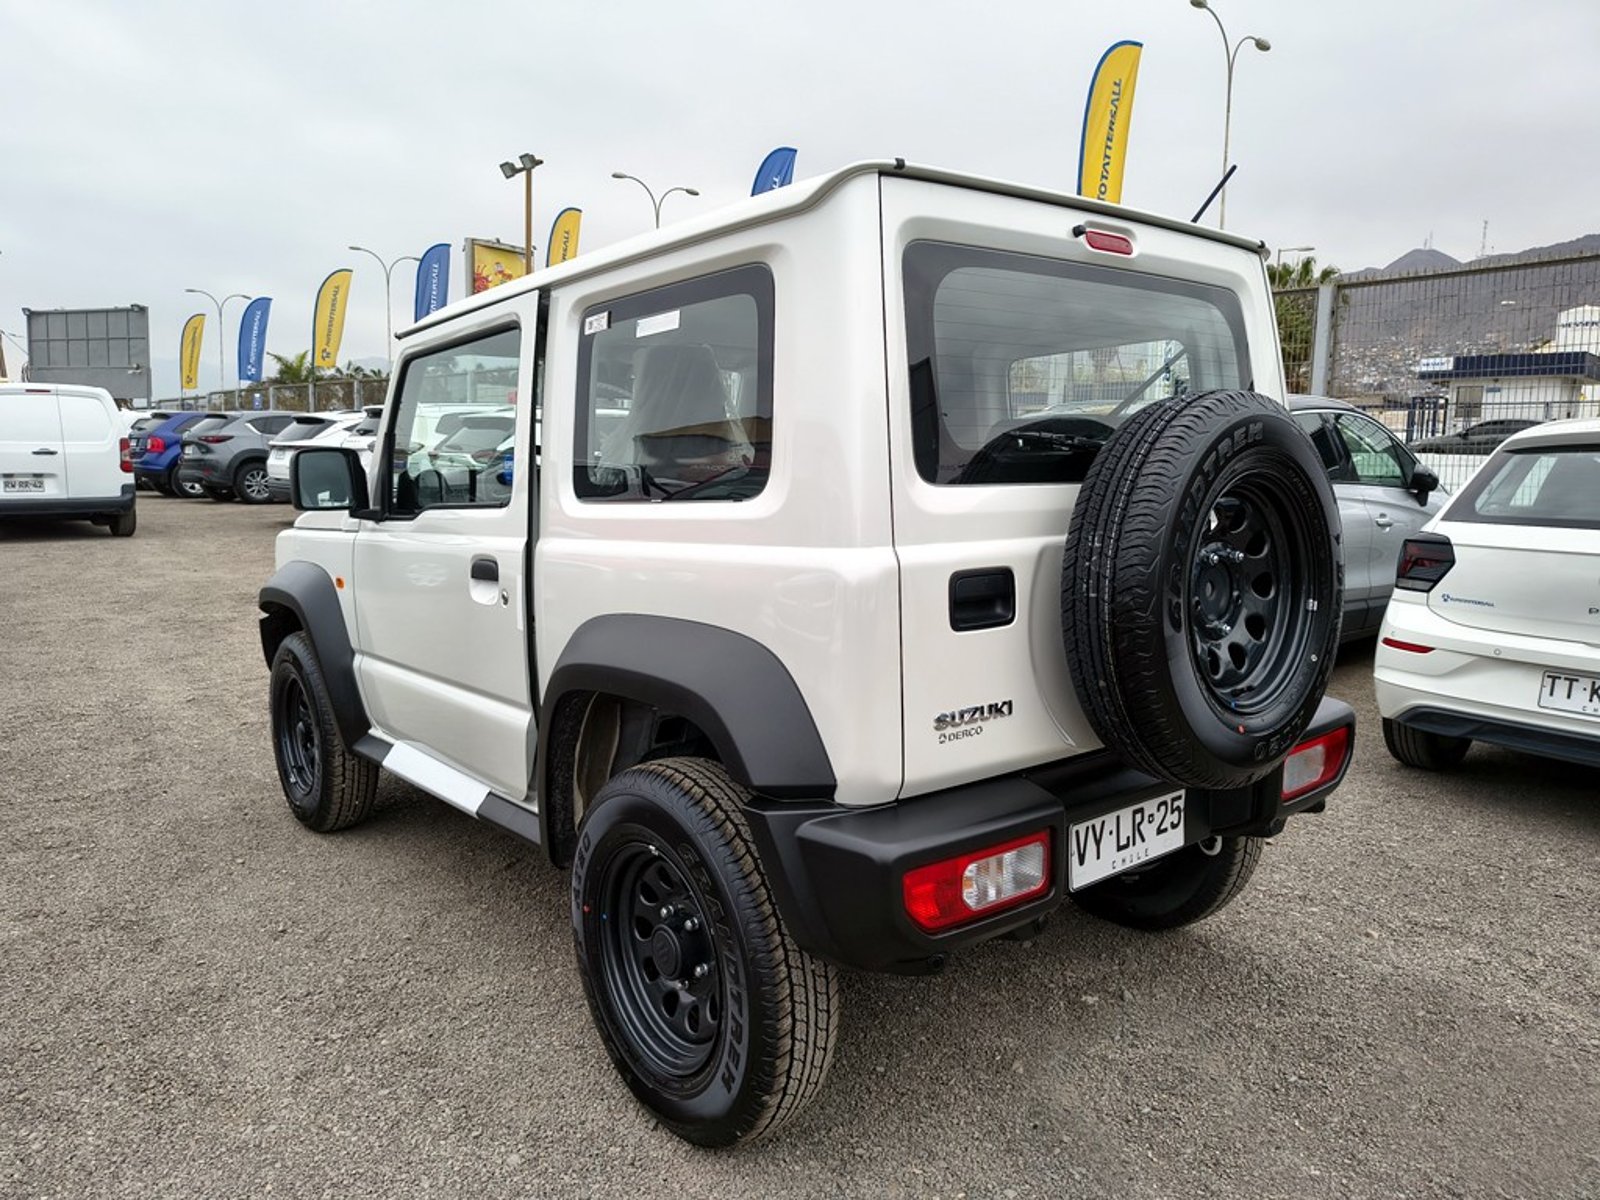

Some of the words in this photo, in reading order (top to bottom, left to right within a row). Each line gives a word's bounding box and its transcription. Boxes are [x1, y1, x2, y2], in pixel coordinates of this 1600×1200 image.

[933, 699, 1013, 731] SUZUKI
[948, 725, 983, 742] DERCO
[1111, 847, 1150, 870] CHILE
